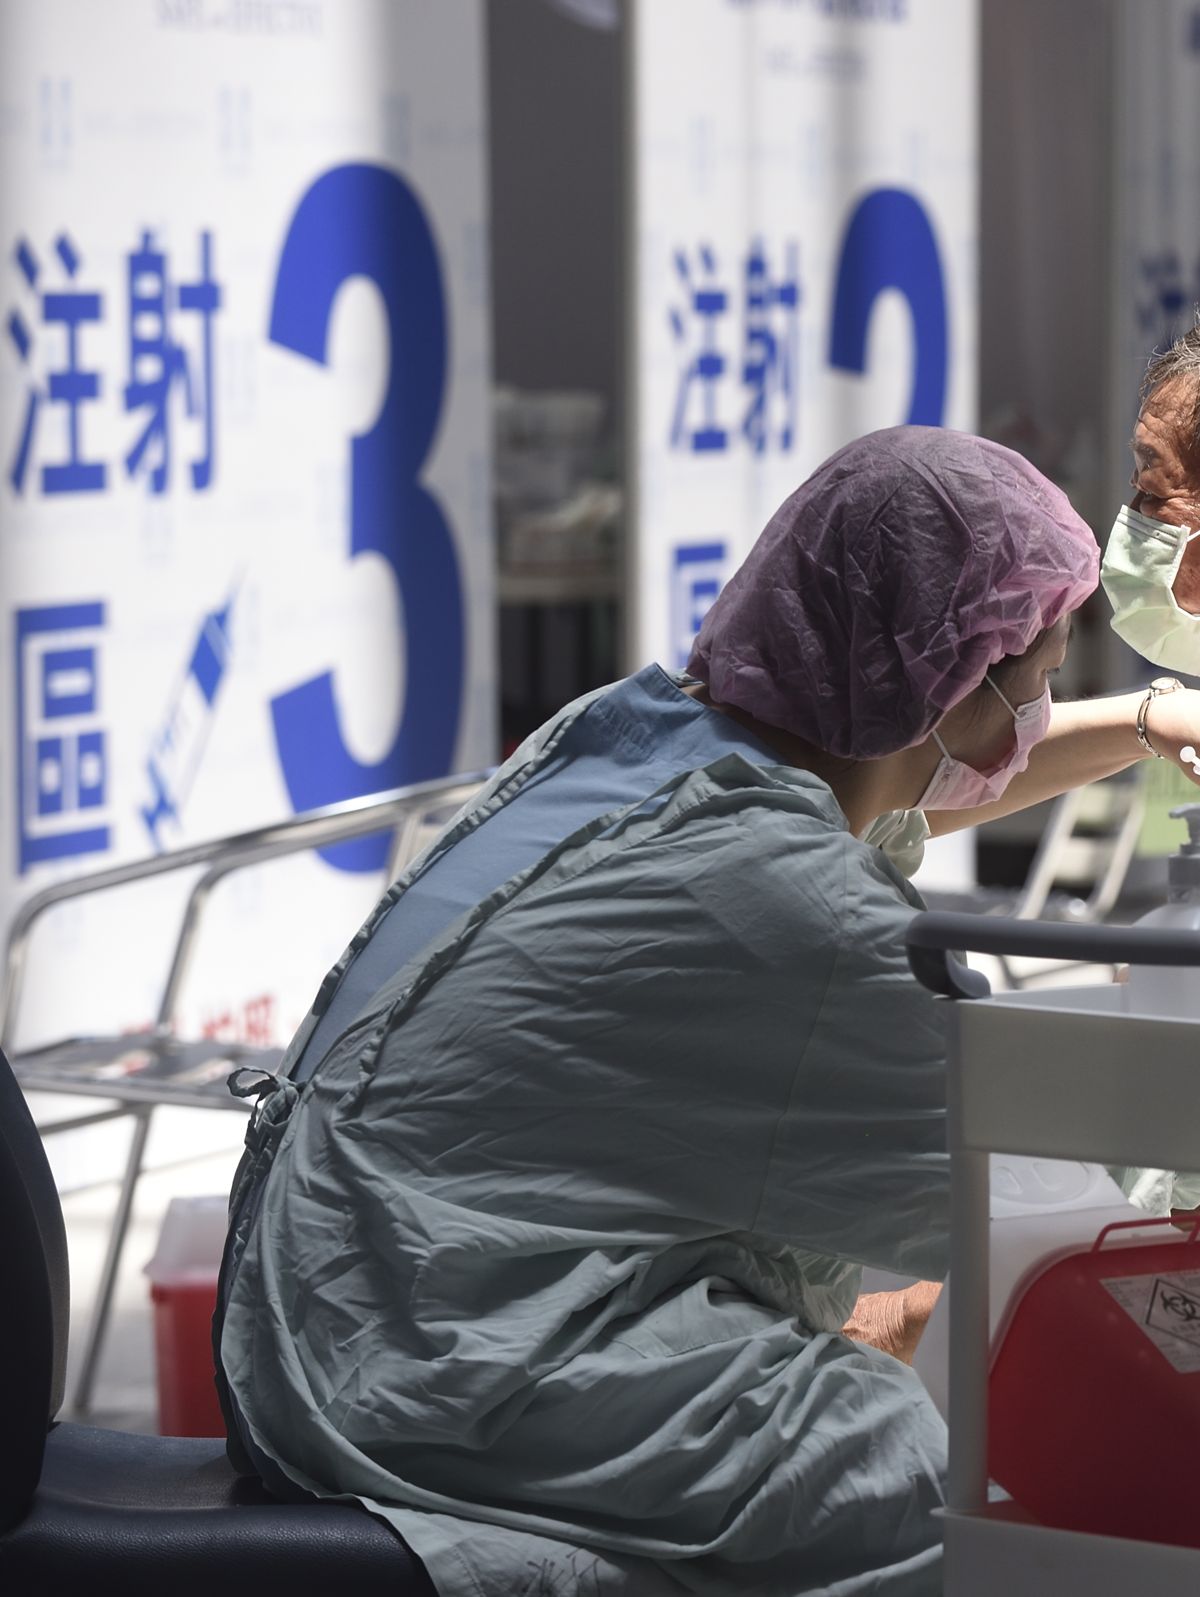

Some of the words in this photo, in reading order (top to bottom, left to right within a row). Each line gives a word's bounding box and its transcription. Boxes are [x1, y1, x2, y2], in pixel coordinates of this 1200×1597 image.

[6, 228, 221, 496] 注射
[669, 236, 802, 457] 注射
[268, 160, 465, 874] 3
[16, 601, 110, 876] 區
